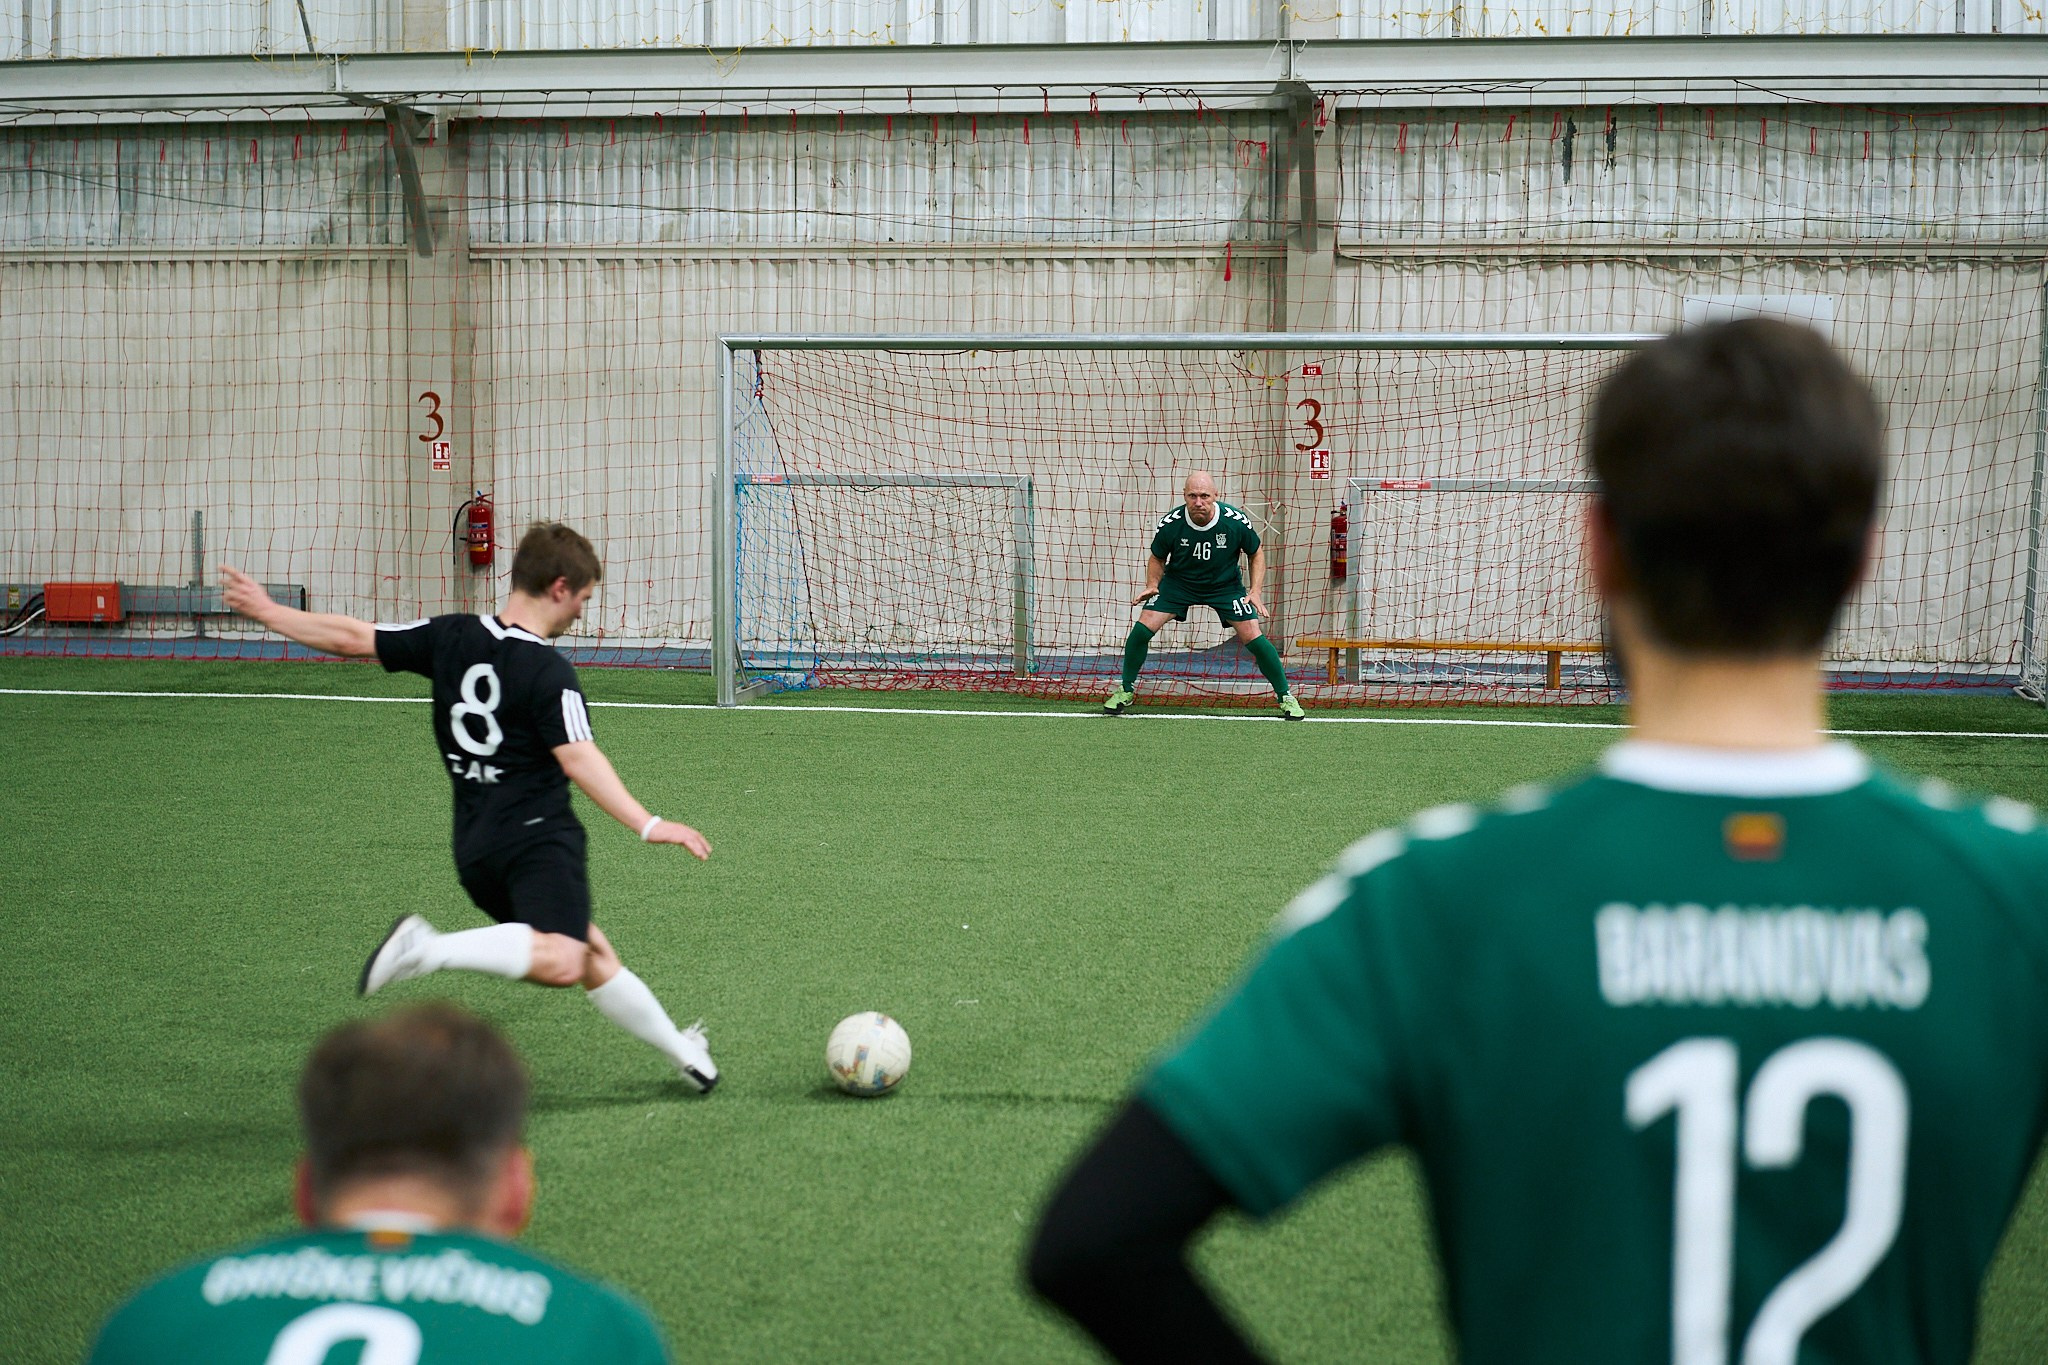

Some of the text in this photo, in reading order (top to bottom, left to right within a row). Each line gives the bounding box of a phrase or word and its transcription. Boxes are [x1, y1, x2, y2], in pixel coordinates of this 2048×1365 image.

[1306, 367, 1317, 375] 112
[418, 391, 444, 442] 3
[1296, 398, 1323, 450] 3
[1193, 541, 1212, 560] 46
[1232, 597, 1253, 617] 46
[450, 663, 504, 756] 8
[1595, 902, 1931, 1009] BARANOVAS
[1624, 1037, 1909, 1365] 12
